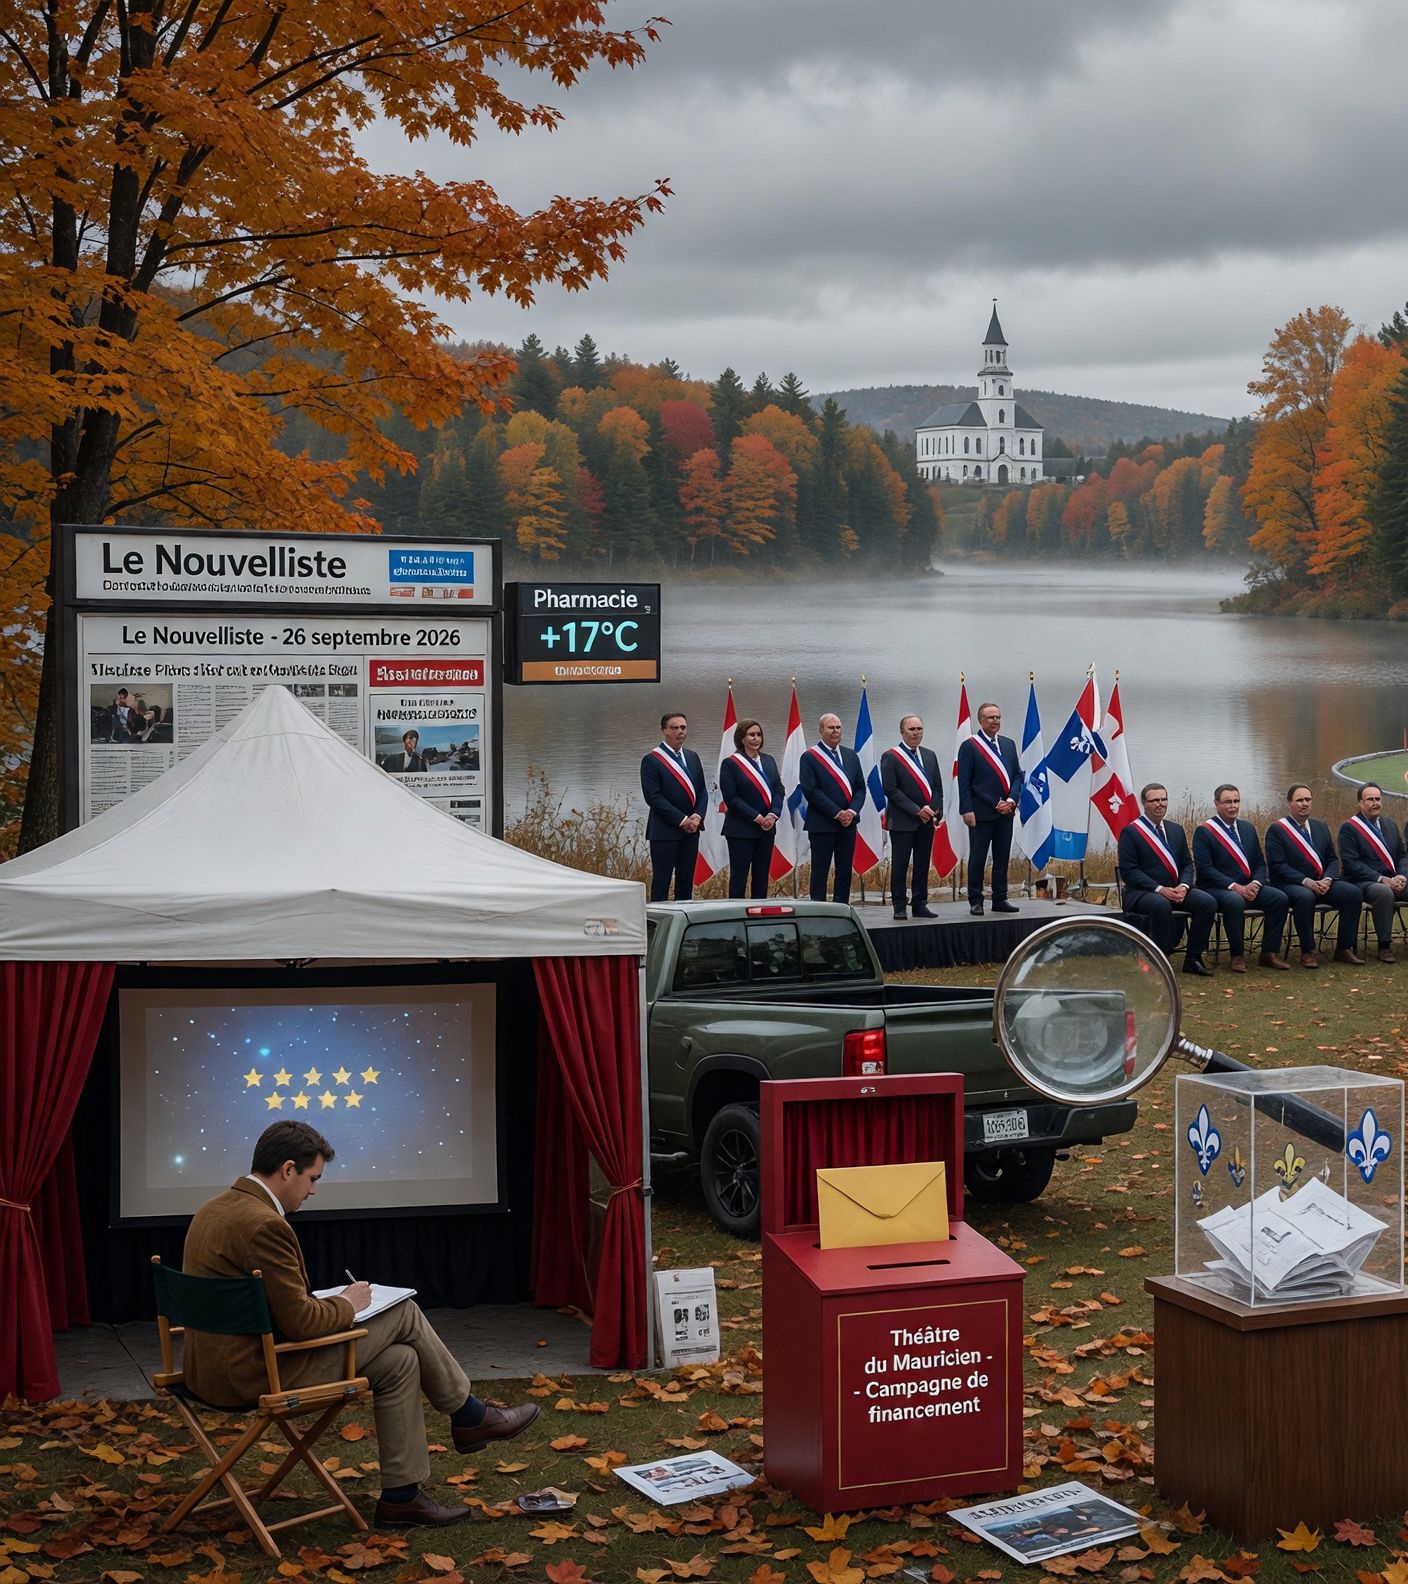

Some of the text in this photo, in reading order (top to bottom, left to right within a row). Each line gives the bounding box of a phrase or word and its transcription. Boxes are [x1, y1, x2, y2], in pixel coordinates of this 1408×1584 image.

[102, 542, 347, 579] Le Nouvelliste
[533, 588, 638, 609] Pharmacie
[122, 625, 147, 645] Le
[153, 626, 264, 646] Nouvelliste
[282, 628, 306, 646] 26
[311, 628, 411, 650] septembre
[416, 629, 461, 647] 2026
[540, 620, 639, 653] +17°C
[890, 1325, 960, 1347] Théâtre
[864, 1356, 887, 1375] du
[893, 1349, 982, 1372] Mauricien
[865, 1376, 962, 1399] Campagne
[966, 1370, 989, 1389] de
[868, 1396, 981, 1424] financement
